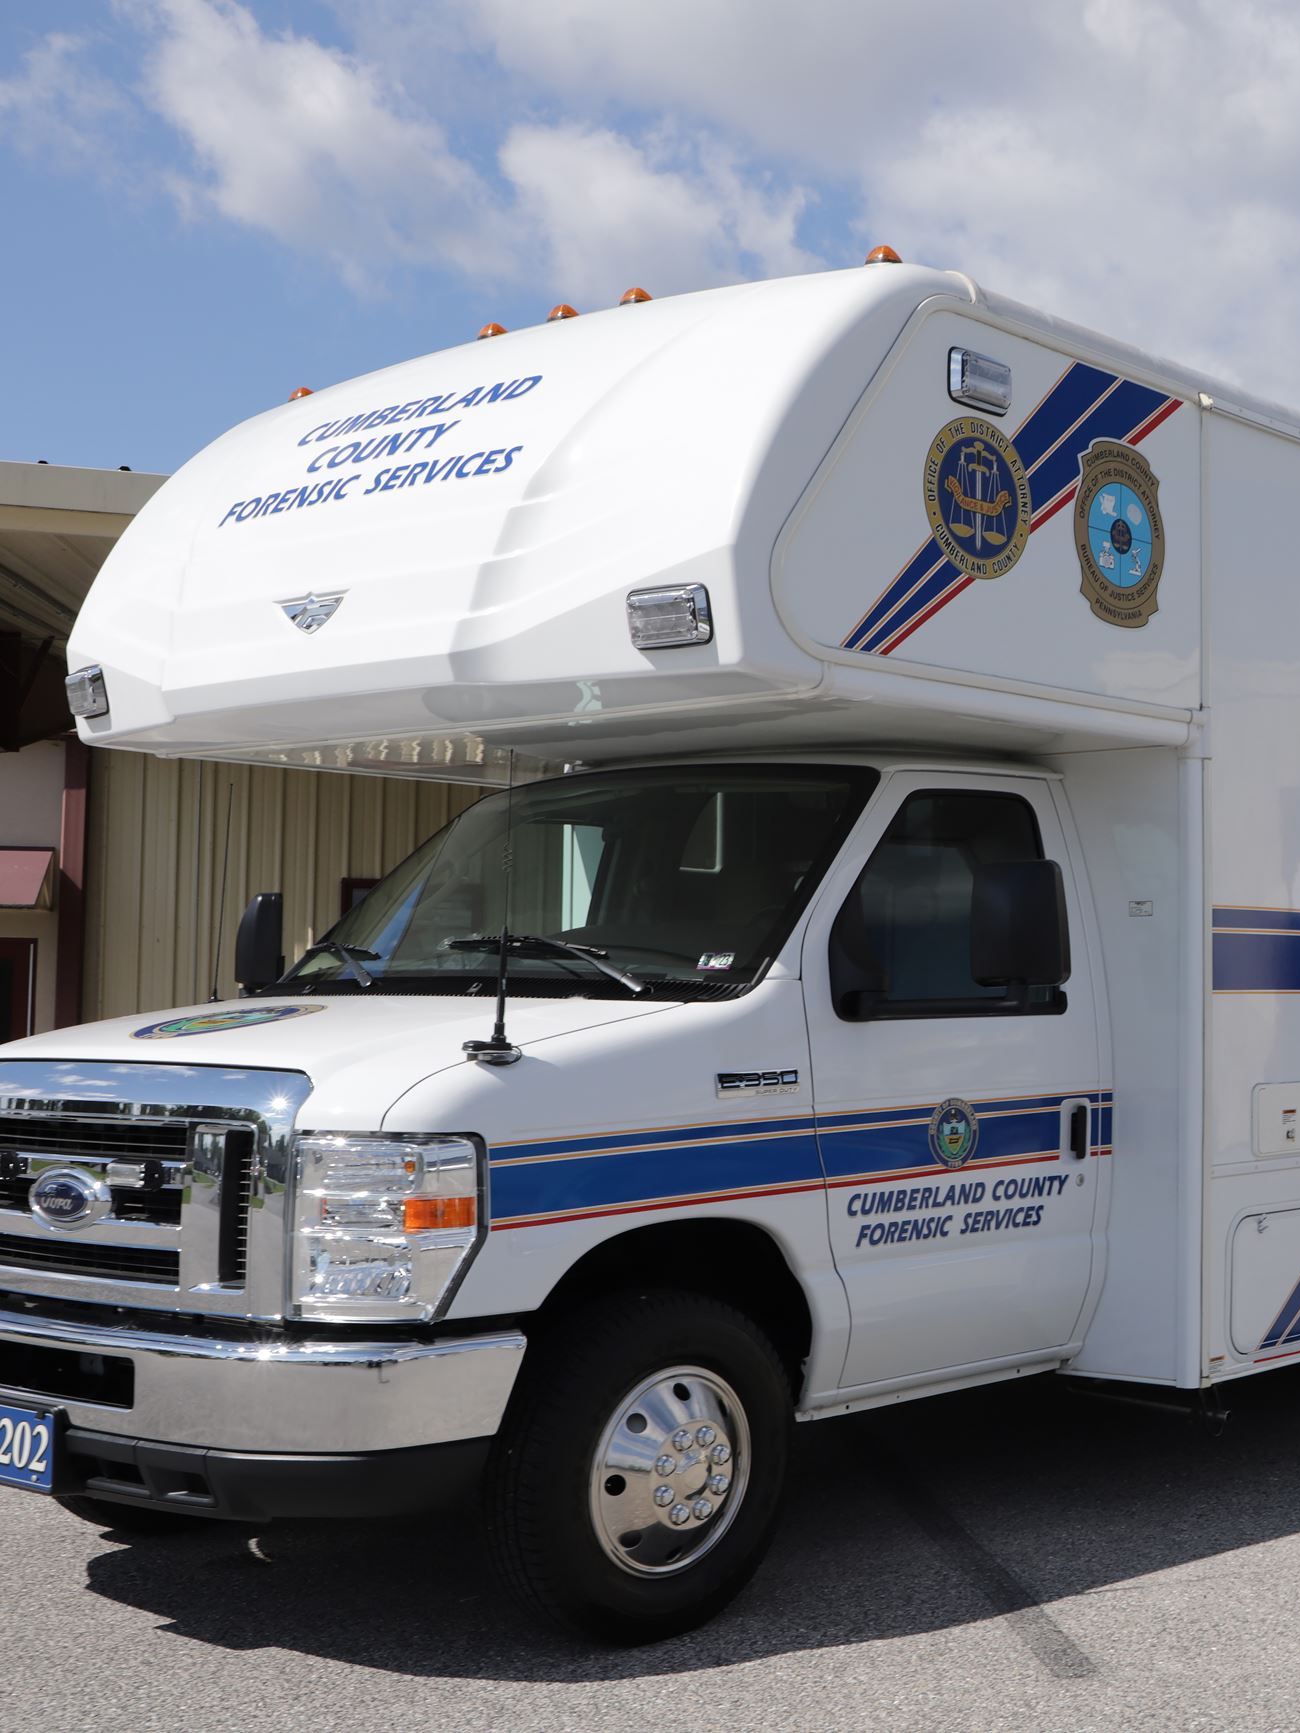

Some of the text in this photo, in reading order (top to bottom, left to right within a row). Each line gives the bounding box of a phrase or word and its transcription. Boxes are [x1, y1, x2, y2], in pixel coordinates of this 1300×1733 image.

[297, 375, 544, 447] CUMBERLAND
[306, 420, 462, 473] COUNTY
[1086, 449, 1156, 487] CUMBERLAND COUNTY
[218, 445, 524, 528] FORENSIC SERVICES
[927, 457, 939, 502] OFFICE
[935, 437, 947, 454] OF
[948, 422, 966, 438] THE
[970, 421, 1009, 453] DISTRICT
[1010, 458, 1028, 526] ATTORNEY
[1079, 467, 1160, 540] OFFICE OF THE DISTRICT ATTORNEY
[935, 523, 1020, 575] CUMBERLAND COUNTY
[1080, 543, 1100, 583] BUREAU
[1100, 581, 1108, 592] OF
[1109, 589, 1136, 602] JUSTICE
[1095, 597, 1142, 620] PENNSYLVANIA
[40, 1184, 74, 1211] Ford
[847, 1174, 1069, 1217] CUMBERLAND COUNTY
[855, 1205, 1044, 1248] FORENSIC SERVICES
